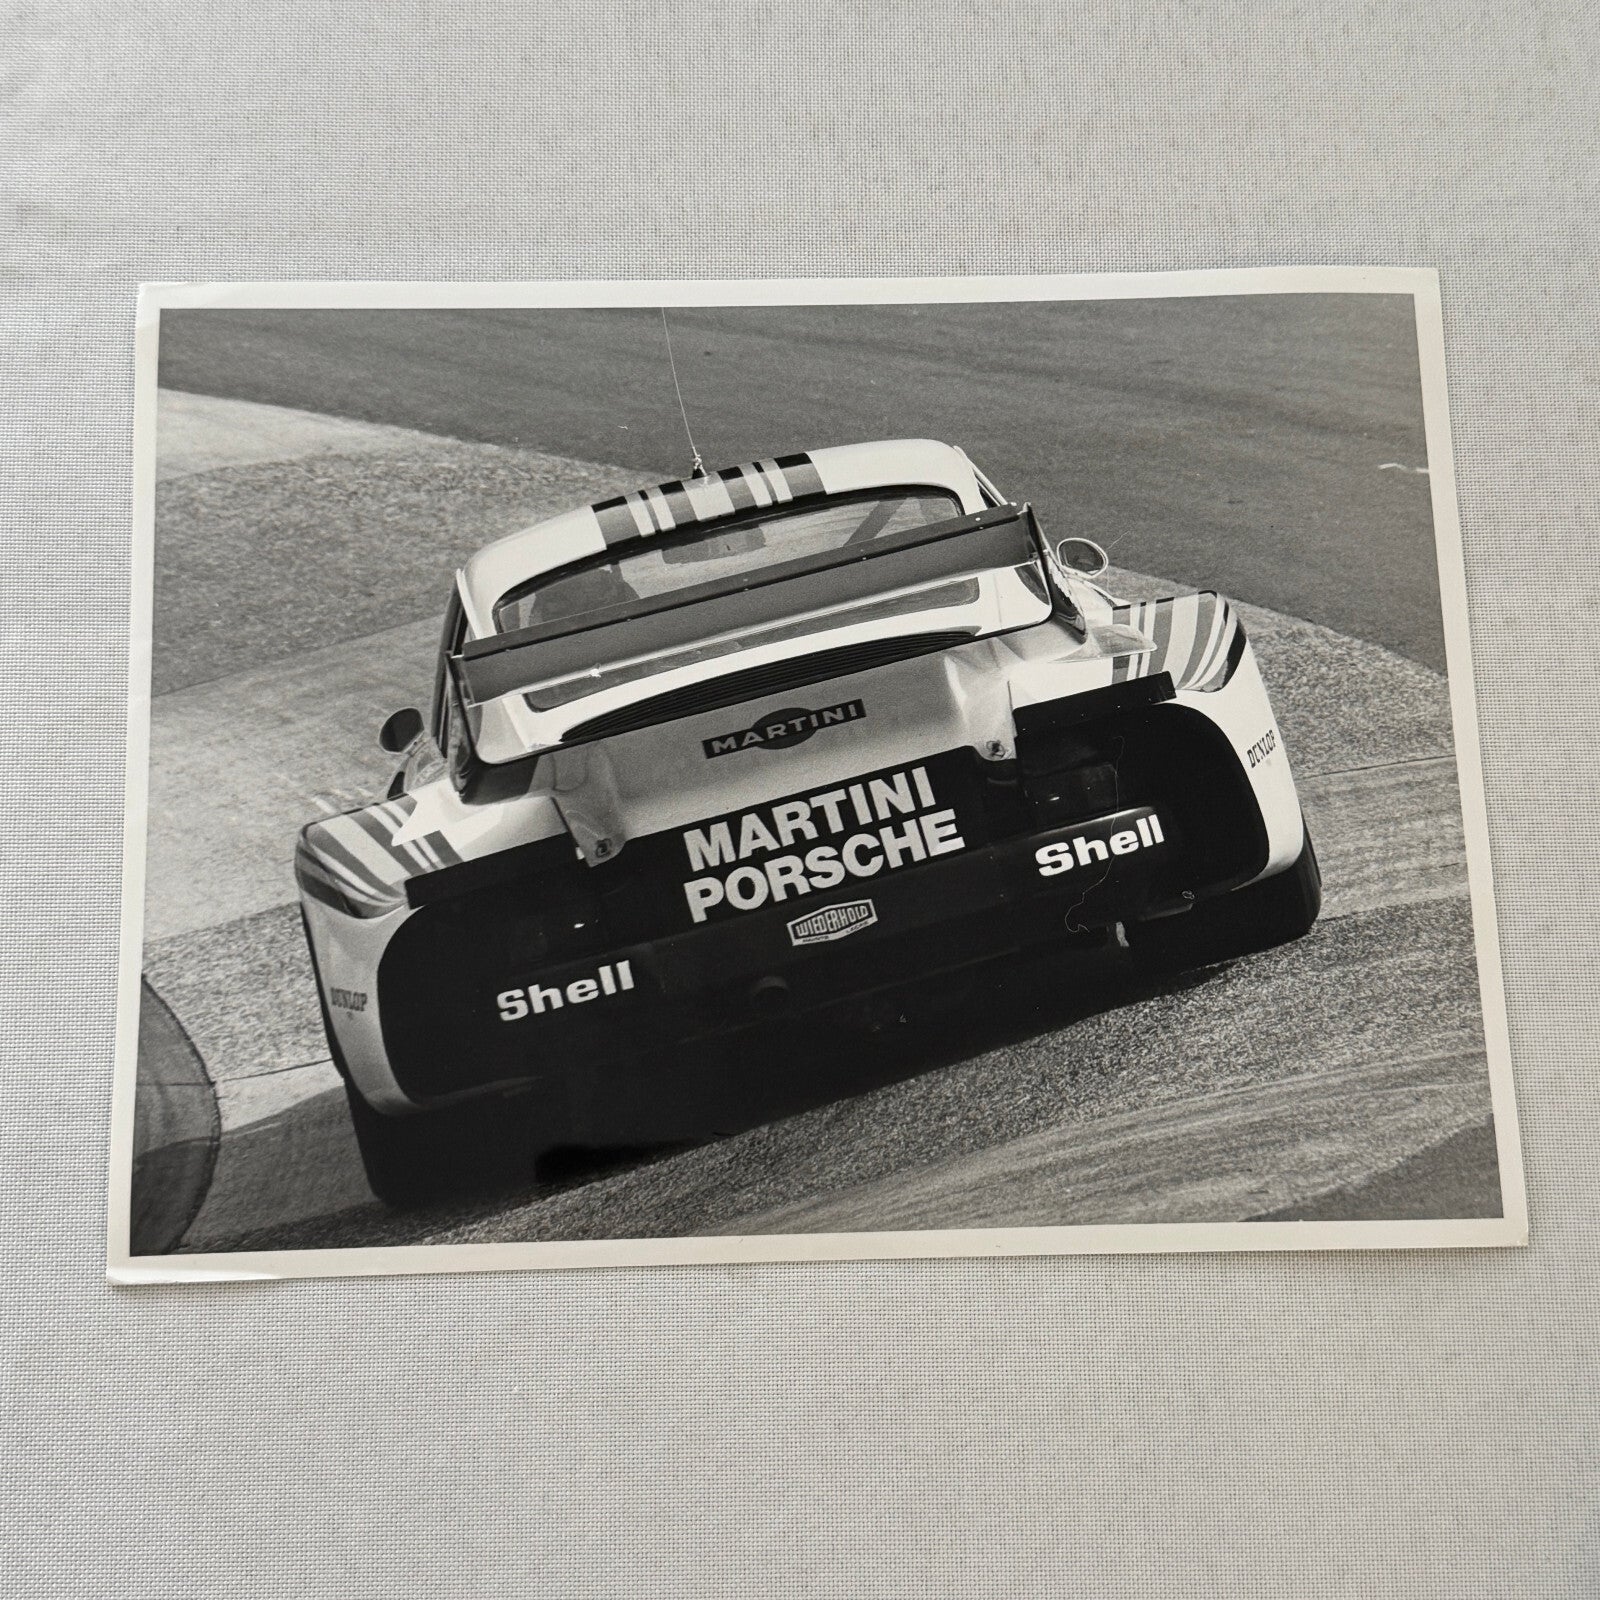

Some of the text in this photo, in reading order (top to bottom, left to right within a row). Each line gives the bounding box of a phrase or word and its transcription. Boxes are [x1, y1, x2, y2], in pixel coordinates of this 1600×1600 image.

[711, 703, 858, 754] MARTINI
[683, 766, 936, 872] MARTINI
[1035, 813, 1165, 877] Shell
[683, 808, 965, 923] PORSCHE
[795, 905, 869, 937] WIEDERHOLD
[496, 959, 635, 1022] Shell
